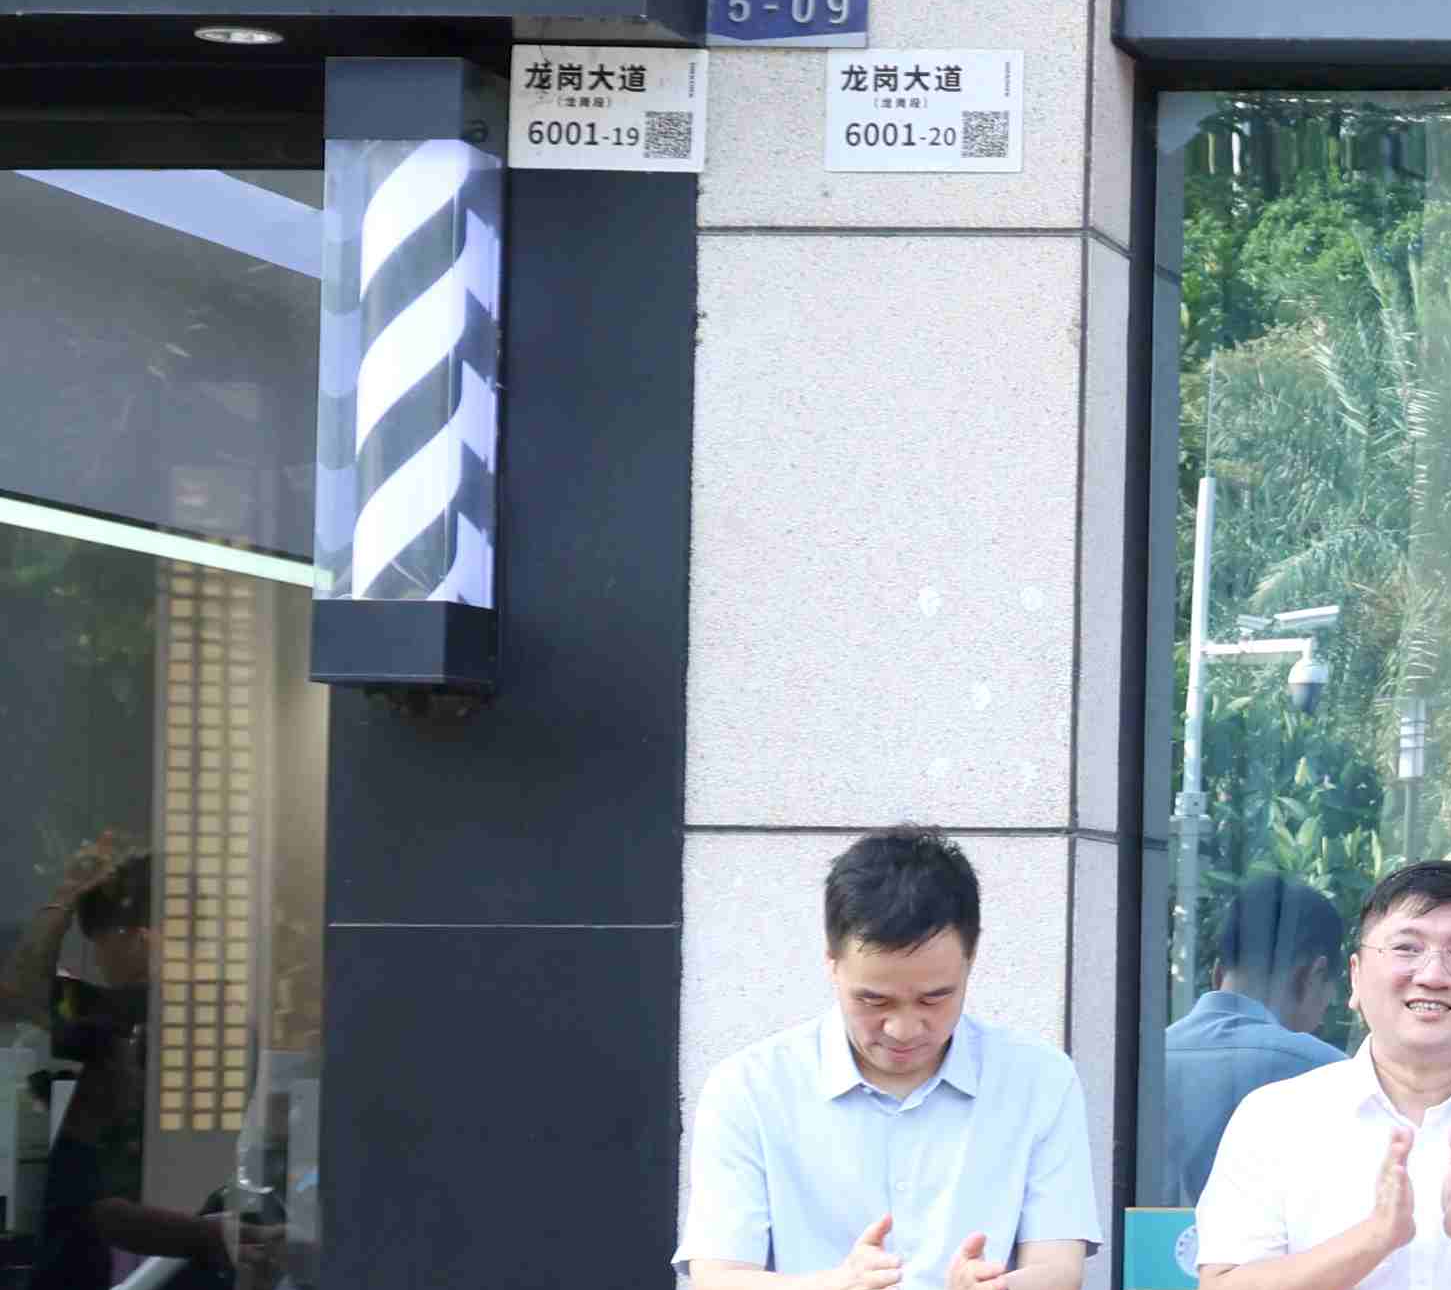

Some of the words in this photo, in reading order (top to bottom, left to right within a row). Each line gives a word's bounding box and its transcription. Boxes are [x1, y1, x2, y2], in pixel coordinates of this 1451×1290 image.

[525, 61, 647, 93] 龙岗大道
[841, 64, 963, 92] 龙岗大道
[528, 120, 640, 146] 6001-19
[845, 122, 957, 146] 6001-20
